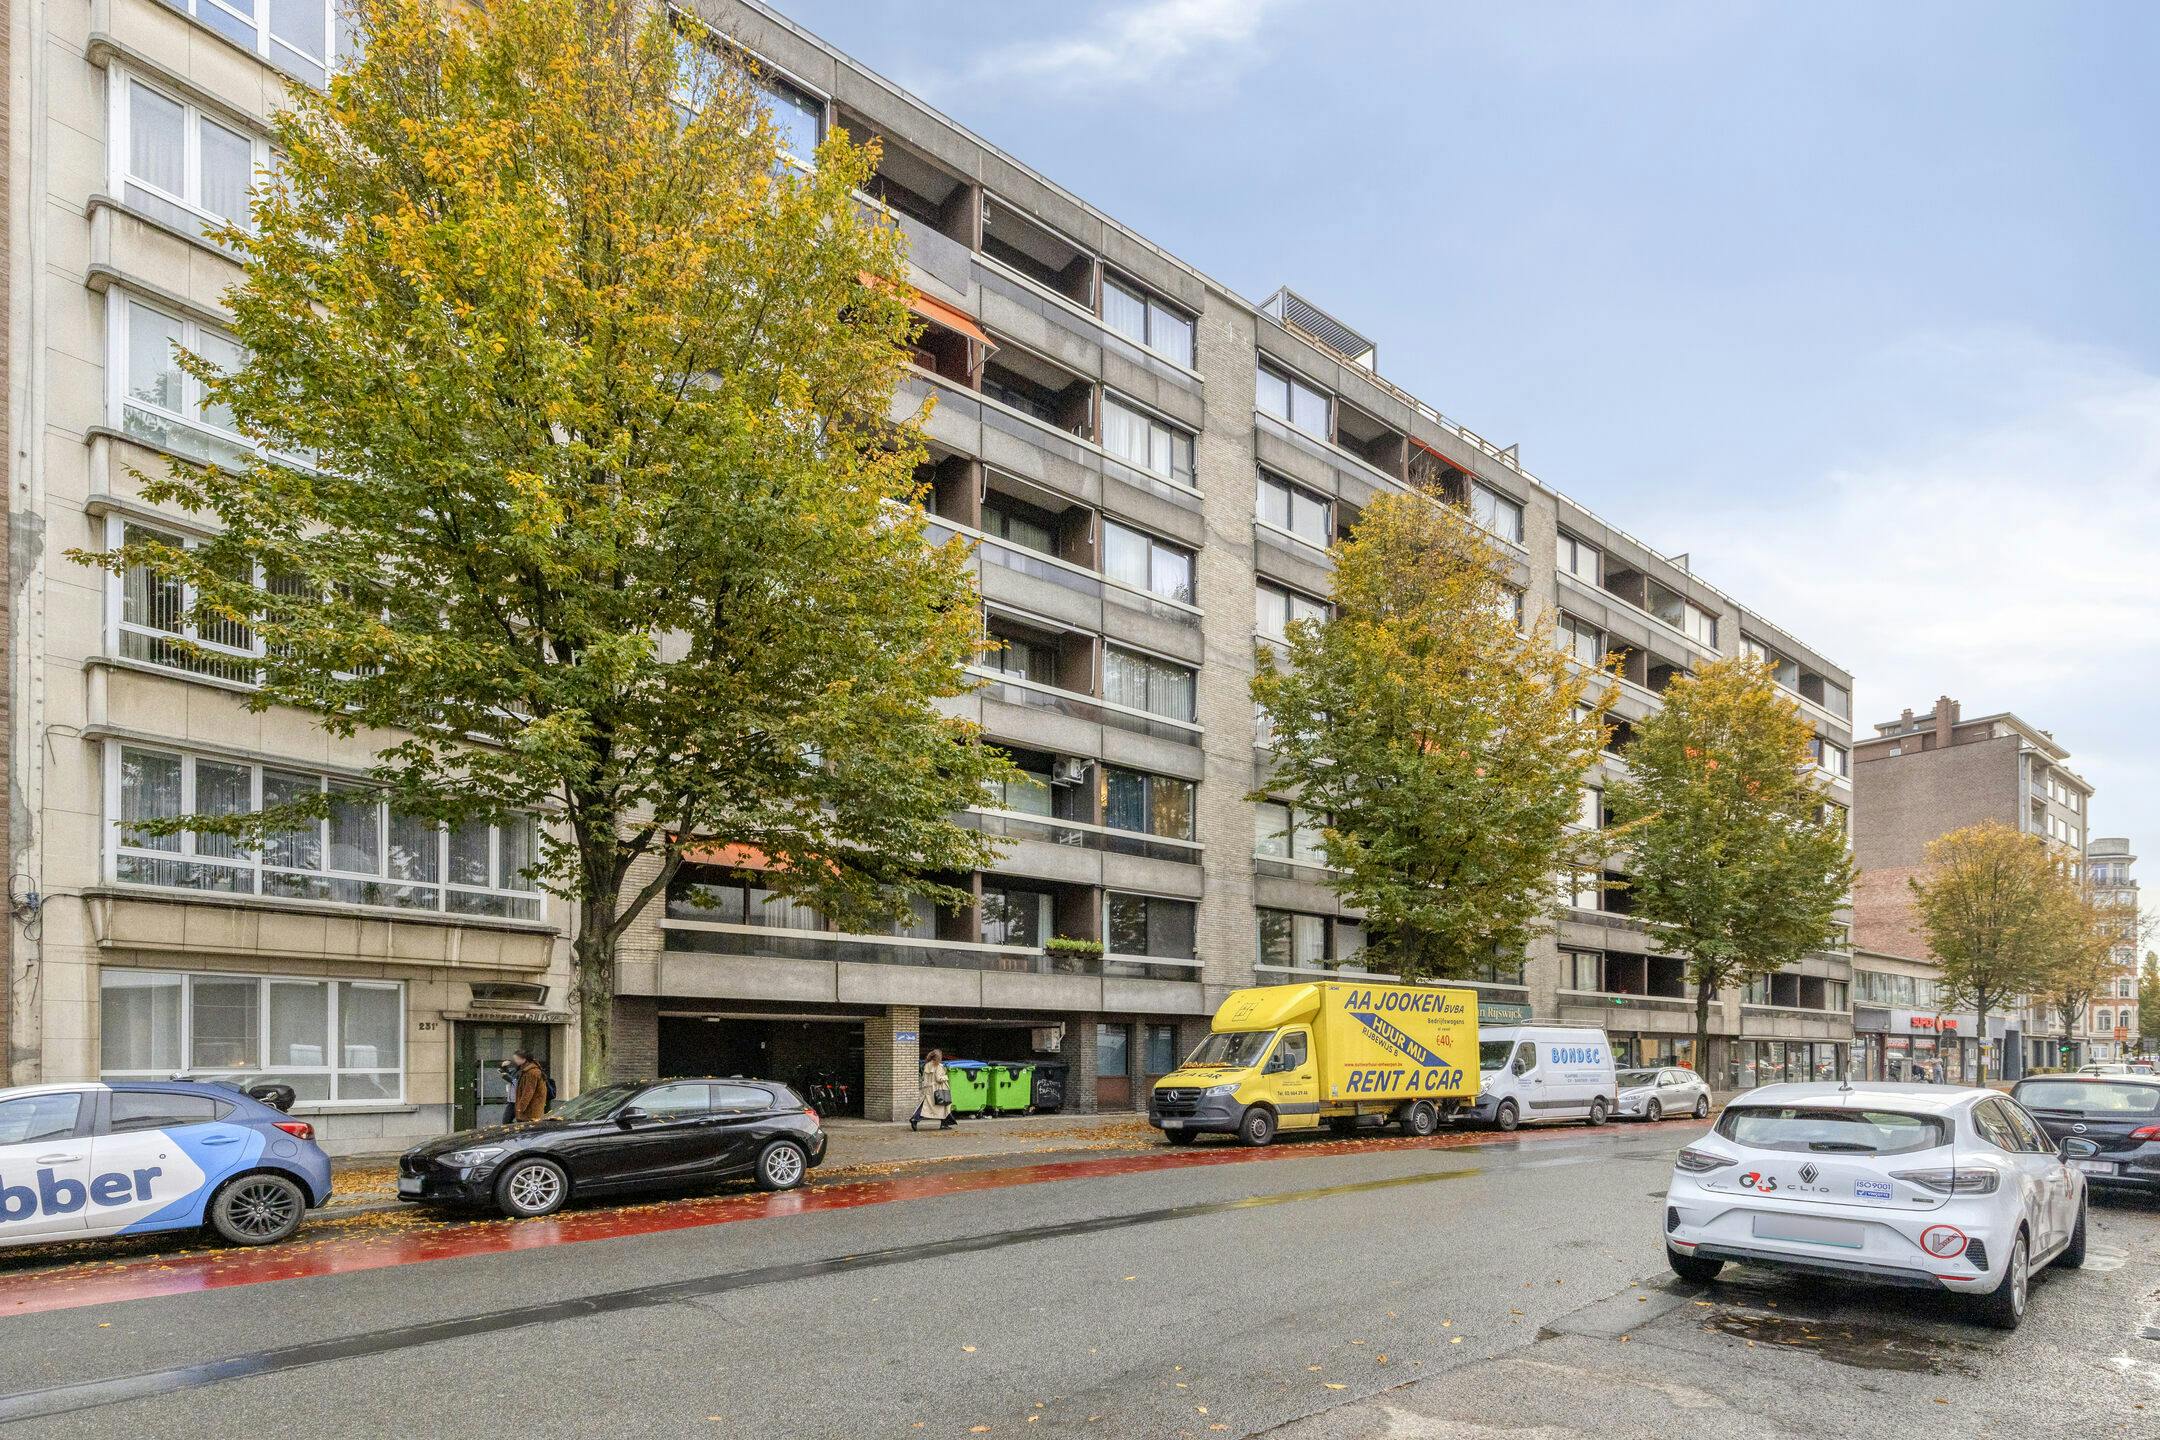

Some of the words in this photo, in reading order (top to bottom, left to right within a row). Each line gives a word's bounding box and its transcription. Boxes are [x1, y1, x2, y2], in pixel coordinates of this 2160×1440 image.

[1344, 990, 1372, 1010] AA
[1374, 991, 1446, 1013] JOOKEN
[1444, 1004, 1465, 1014] BVBA
[1487, 1007, 1522, 1020] Rijswijck
[1372, 1017, 1406, 1049] HUUR
[1406, 1041, 1427, 1063] MIJ
[1551, 1047, 1600, 1064] BONDEC
[1346, 1070, 1405, 1093] RENT
[1405, 1069, 1420, 1091] A
[1424, 1069, 1463, 1091] CAR
[1739, 1171, 1778, 1193] G4S
[1787, 1184, 1830, 1193] CLIO
[1856, 1181, 1871, 1189] ISO
[1871, 1182, 1891, 1190] 9001
